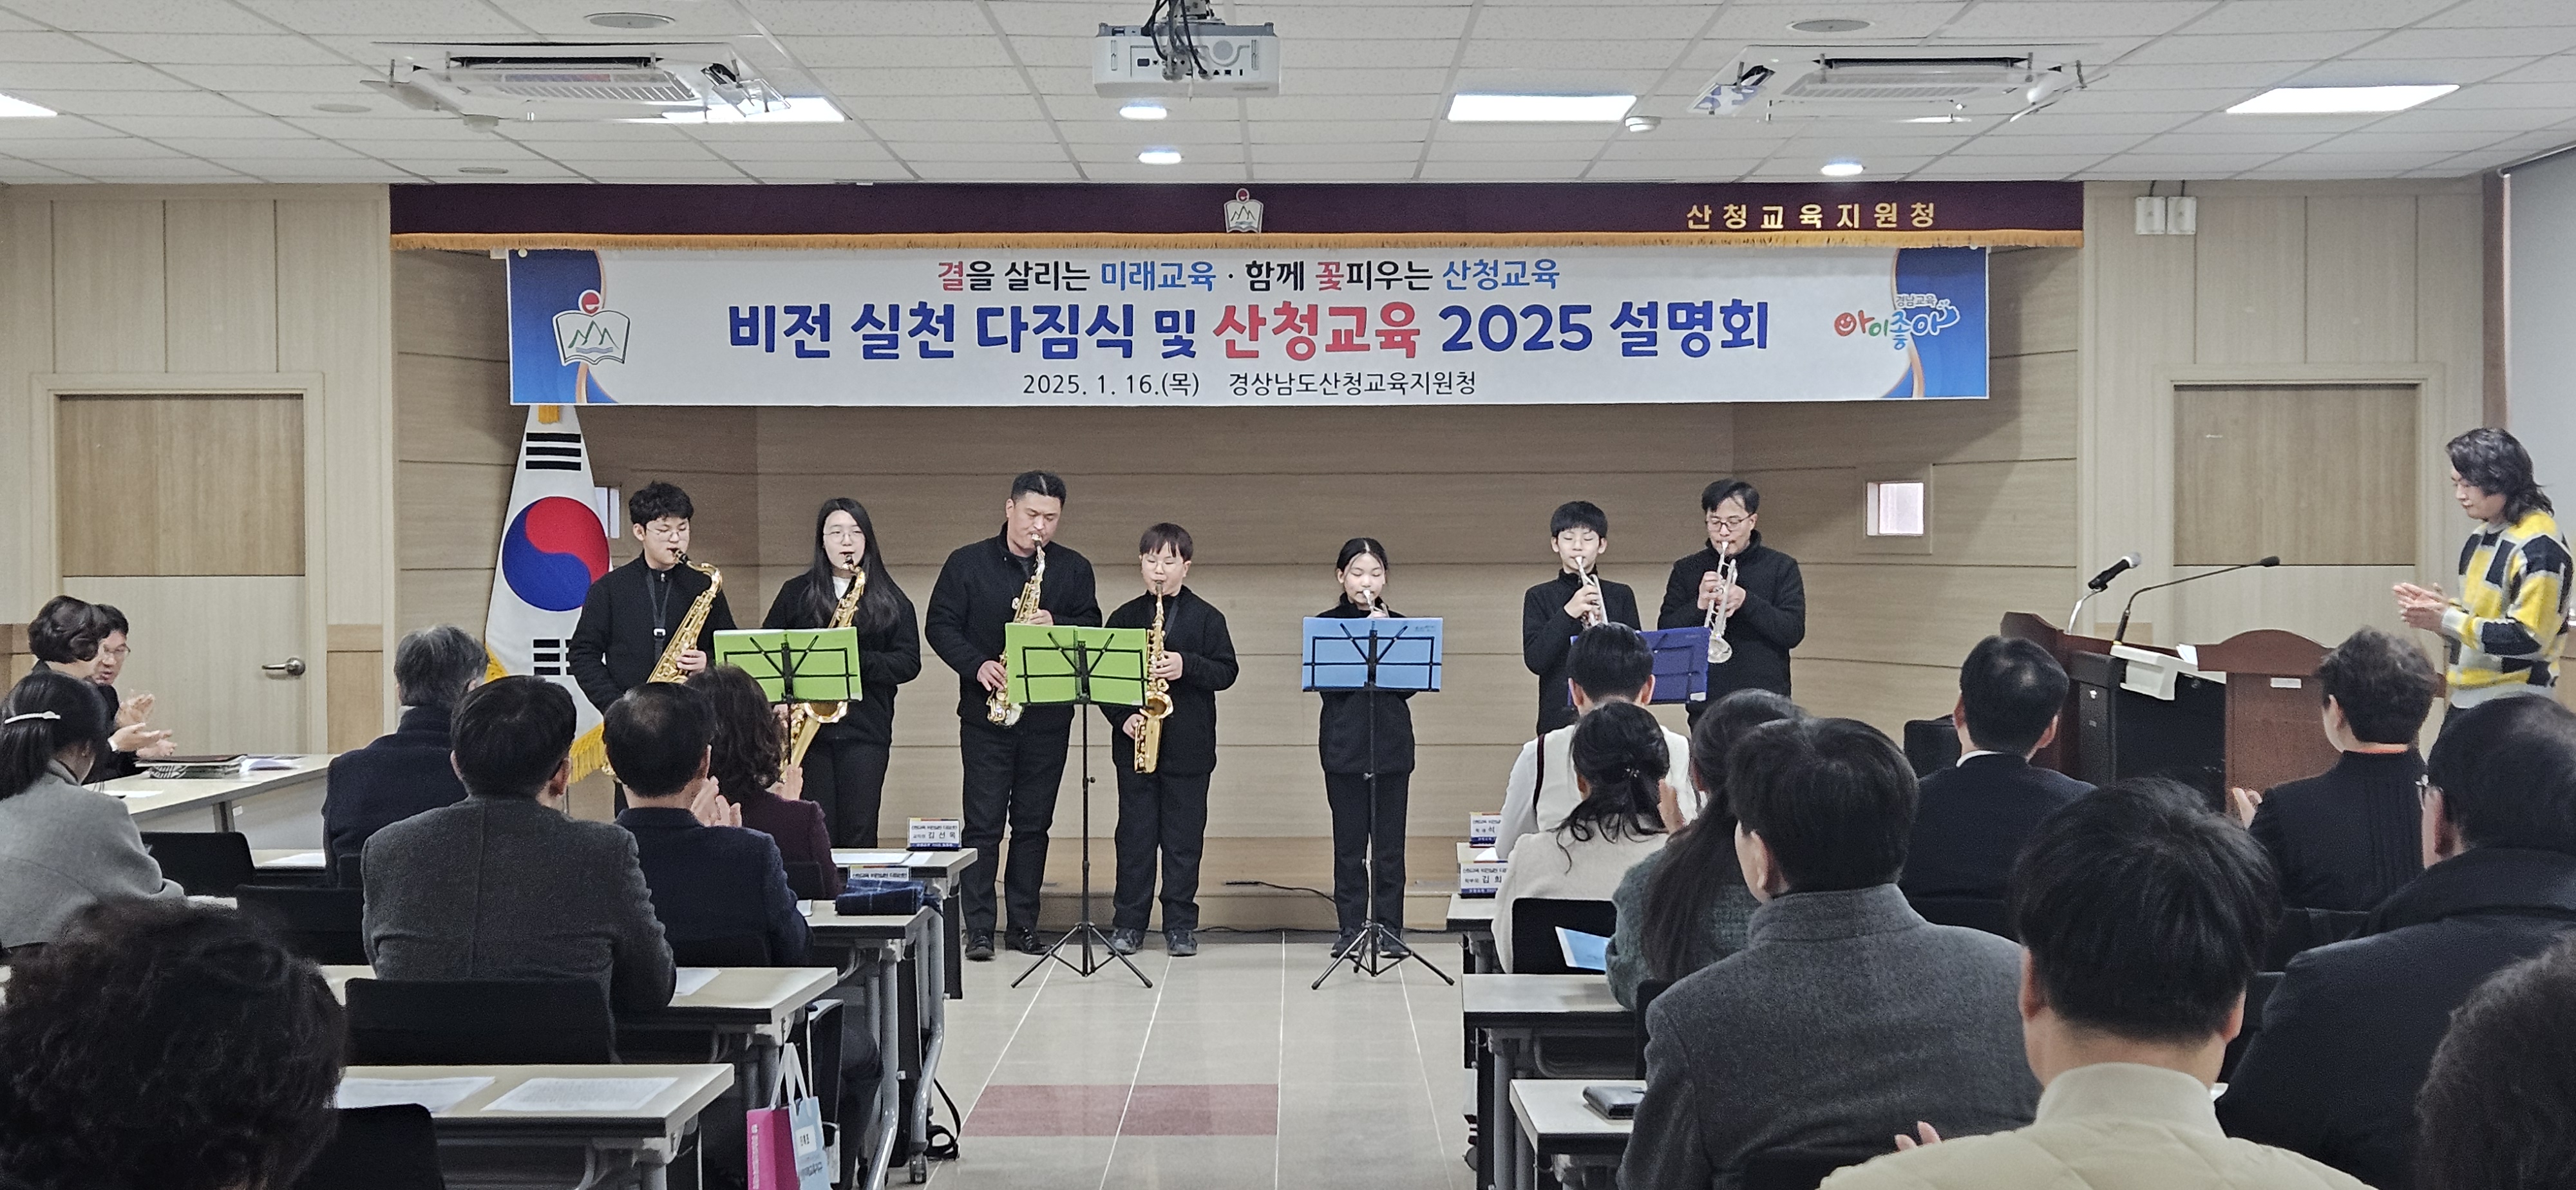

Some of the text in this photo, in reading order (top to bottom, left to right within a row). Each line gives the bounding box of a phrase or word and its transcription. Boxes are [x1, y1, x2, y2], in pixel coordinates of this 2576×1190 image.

[1686, 202, 1937, 230] 산청교육지원청
[938, 260, 995, 292] 결을
[1004, 260, 1091, 292] 살리는
[1101, 260, 1217, 292] 미래교육
[1245, 260, 1304, 292] 함께
[1315, 260, 1434, 292] 꽃피우는
[1443, 258, 1560, 291] 산청교육
[1895, 294, 1937, 308] 경남교육
[728, 299, 1768, 361] 비전 실천 다짐식 및 산청교육 2025 설명회
[1833, 305, 1960, 350] 아이좋아
[1023, 371, 1476, 397] 2025. 1. 16.(목) 경상남도산청교육지원청
